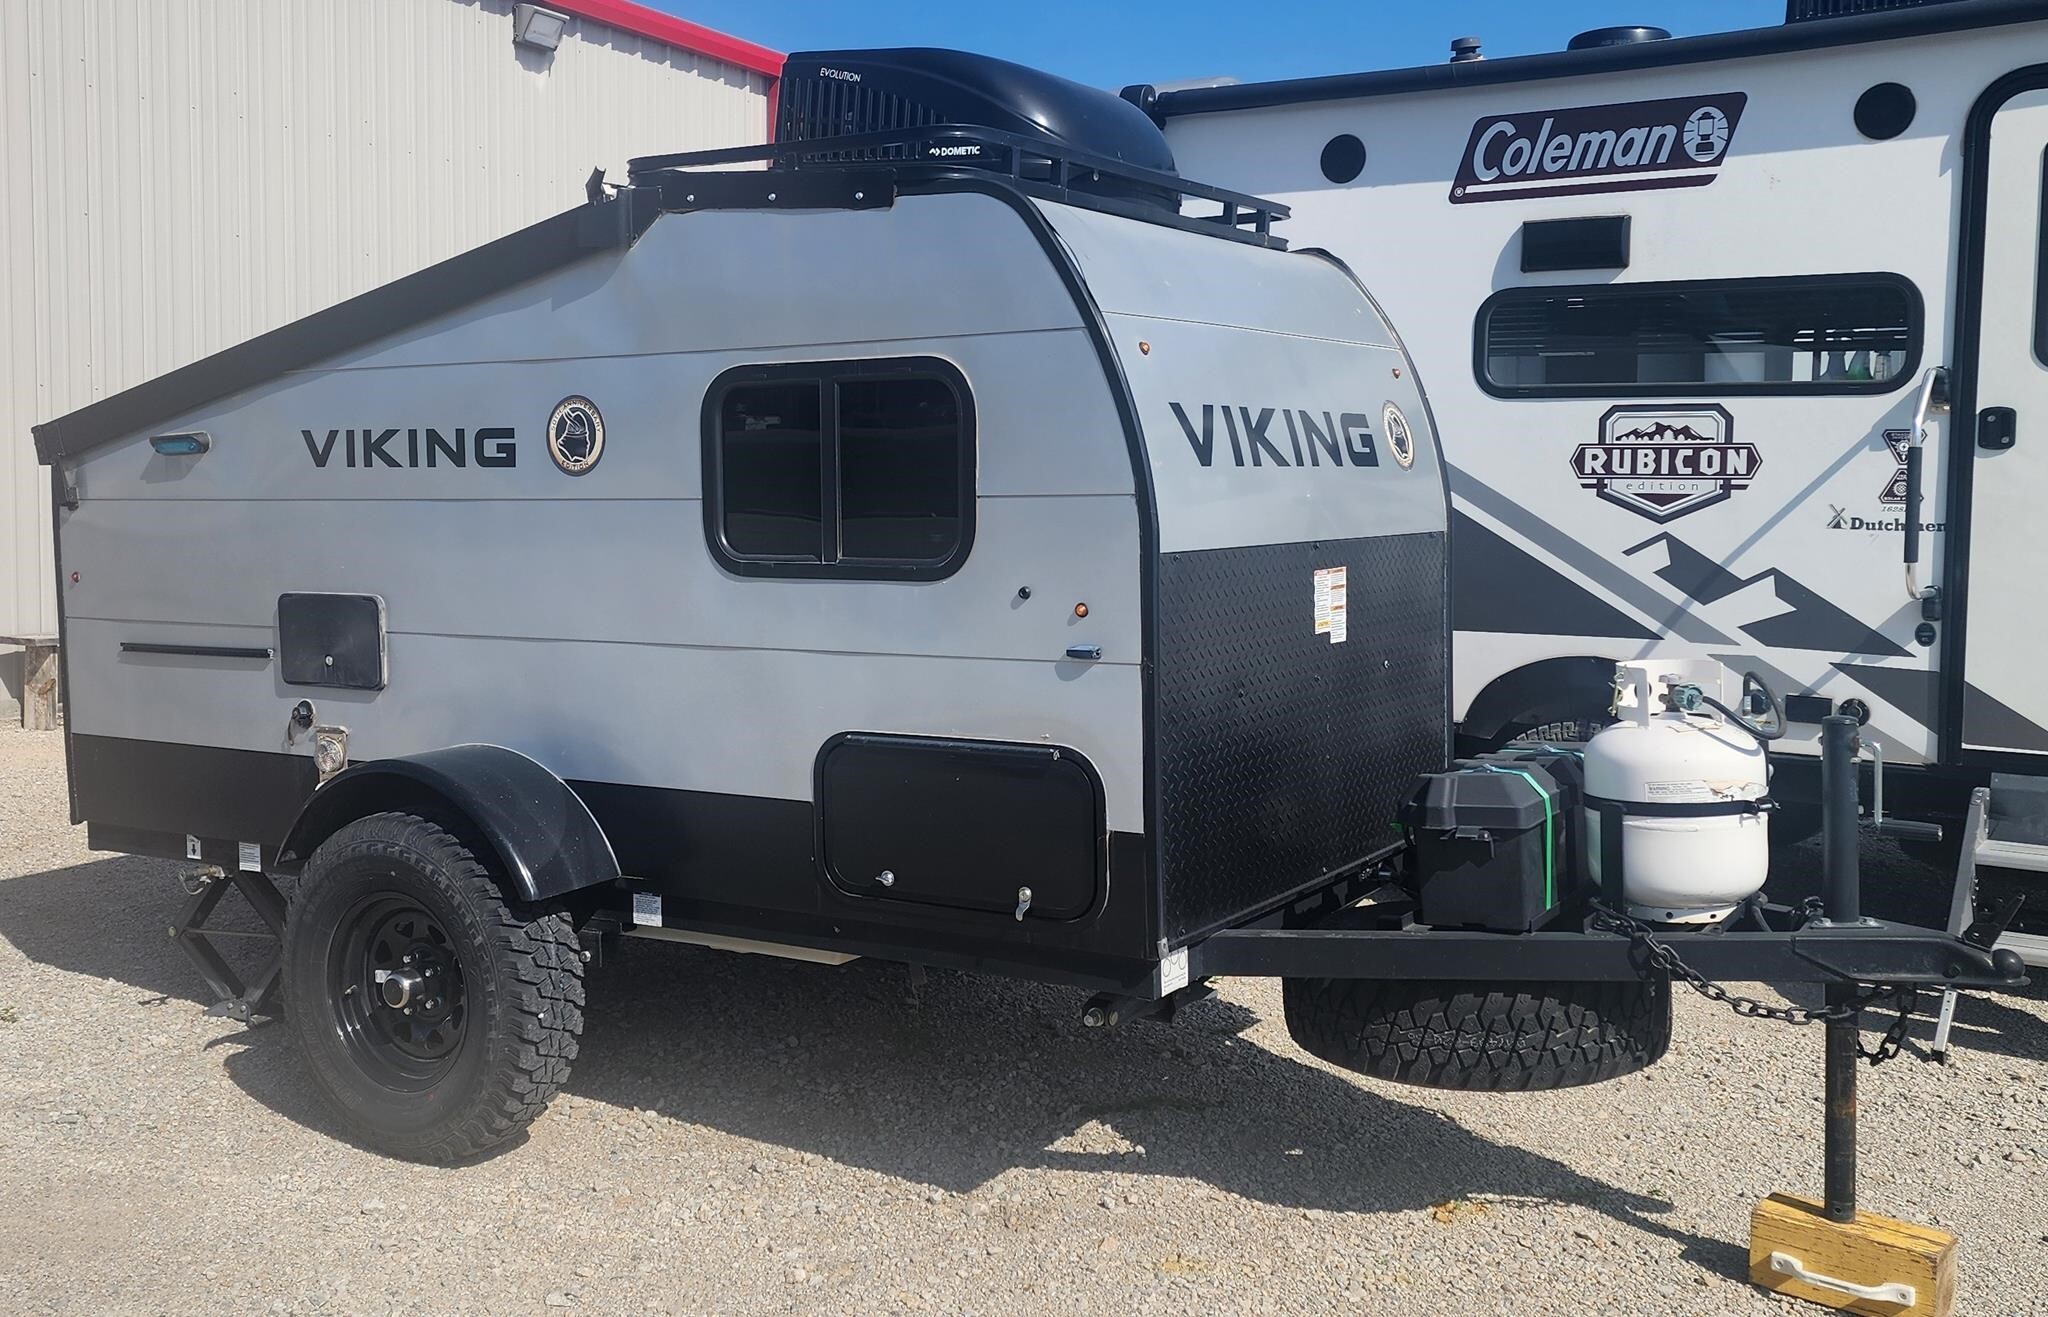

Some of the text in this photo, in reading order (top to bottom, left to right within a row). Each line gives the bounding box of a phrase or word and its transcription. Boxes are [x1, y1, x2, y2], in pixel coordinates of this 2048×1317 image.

[820, 67, 862, 82] EVOLUTION
[940, 145, 981, 156] DOMETIC
[1473, 117, 1678, 182] Coleman
[1168, 402, 1380, 467] VIKING
[301, 427, 517, 468] VIKING
[561, 460, 589, 470] EDITION
[1584, 448, 1748, 476] RUBICON
[1626, 482, 1699, 491] edition
[1849, 517, 1946, 532] Dutchen
